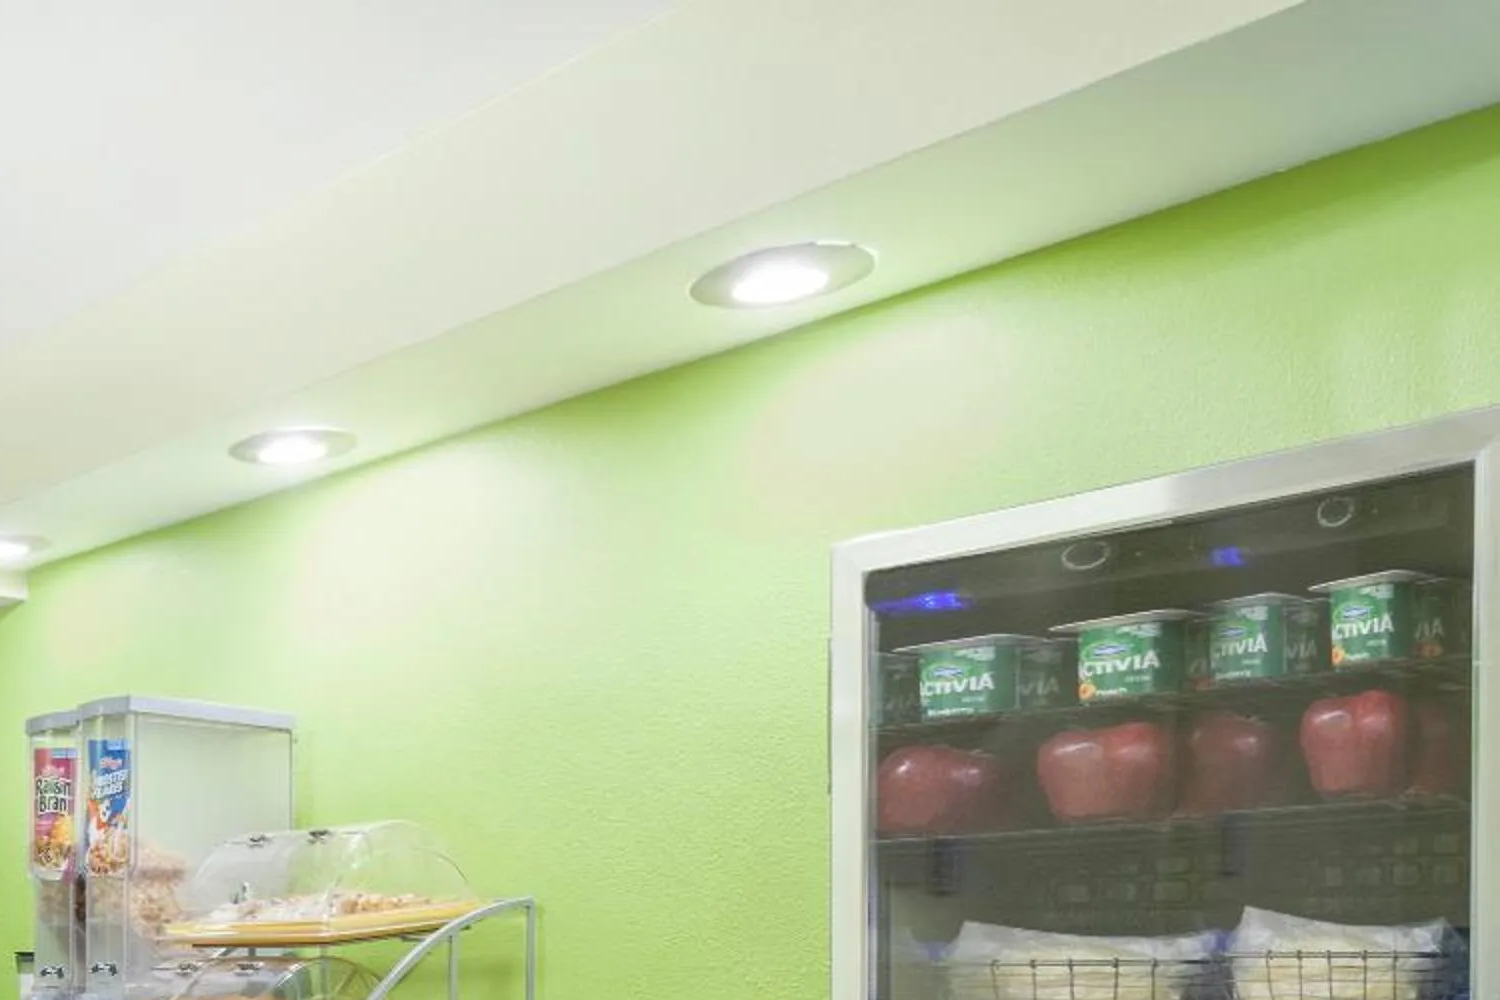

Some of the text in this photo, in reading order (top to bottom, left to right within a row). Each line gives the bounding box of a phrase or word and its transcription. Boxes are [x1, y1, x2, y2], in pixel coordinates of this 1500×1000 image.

[1332, 612, 1395, 640] CTIVIA
[1079, 649, 1160, 679] CTIVIA
[920, 672, 995, 697] CTIVIA
[39, 795, 67, 812] Bran
